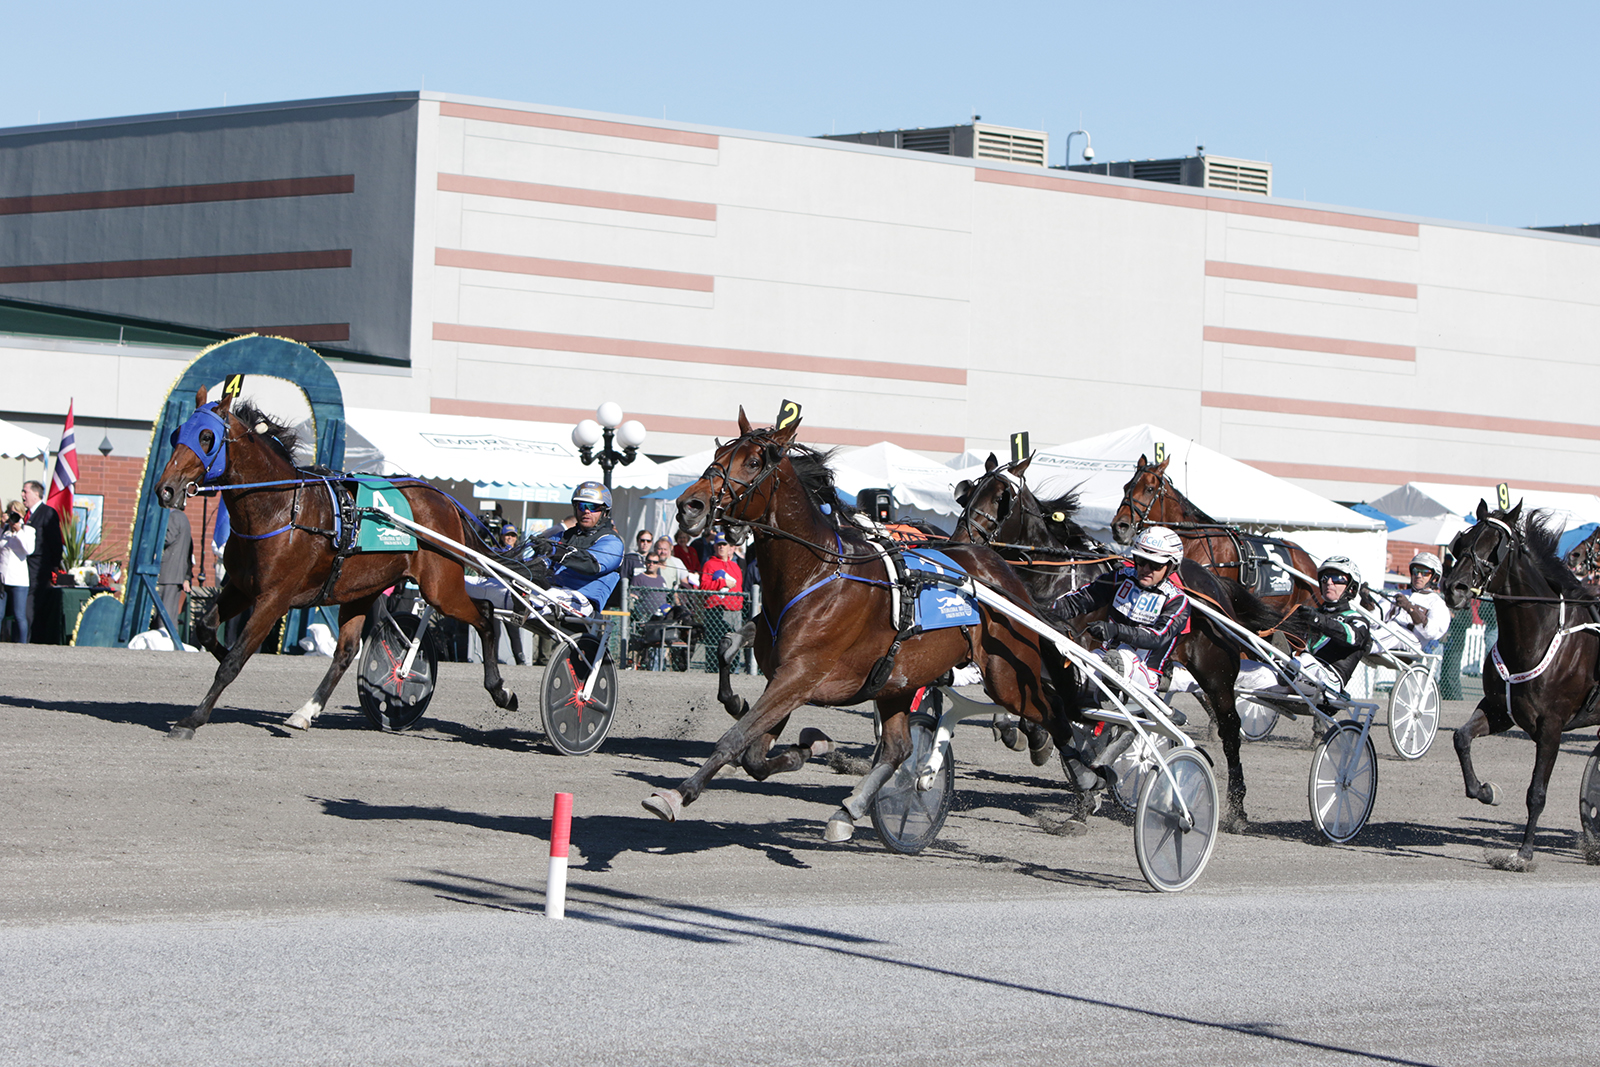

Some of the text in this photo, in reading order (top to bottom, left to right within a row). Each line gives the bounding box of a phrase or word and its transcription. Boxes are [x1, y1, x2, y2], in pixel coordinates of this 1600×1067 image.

[225, 374, 241, 398] 4
[779, 402, 798, 429] 2
[1015, 433, 1023, 460] 1
[1156, 443, 1163, 463] 5
[1037, 456, 1100, 468] EMPIRE
[373, 490, 395, 514] 4
[508, 486, 561, 502] BEER
[1499, 483, 1508, 510] 9
